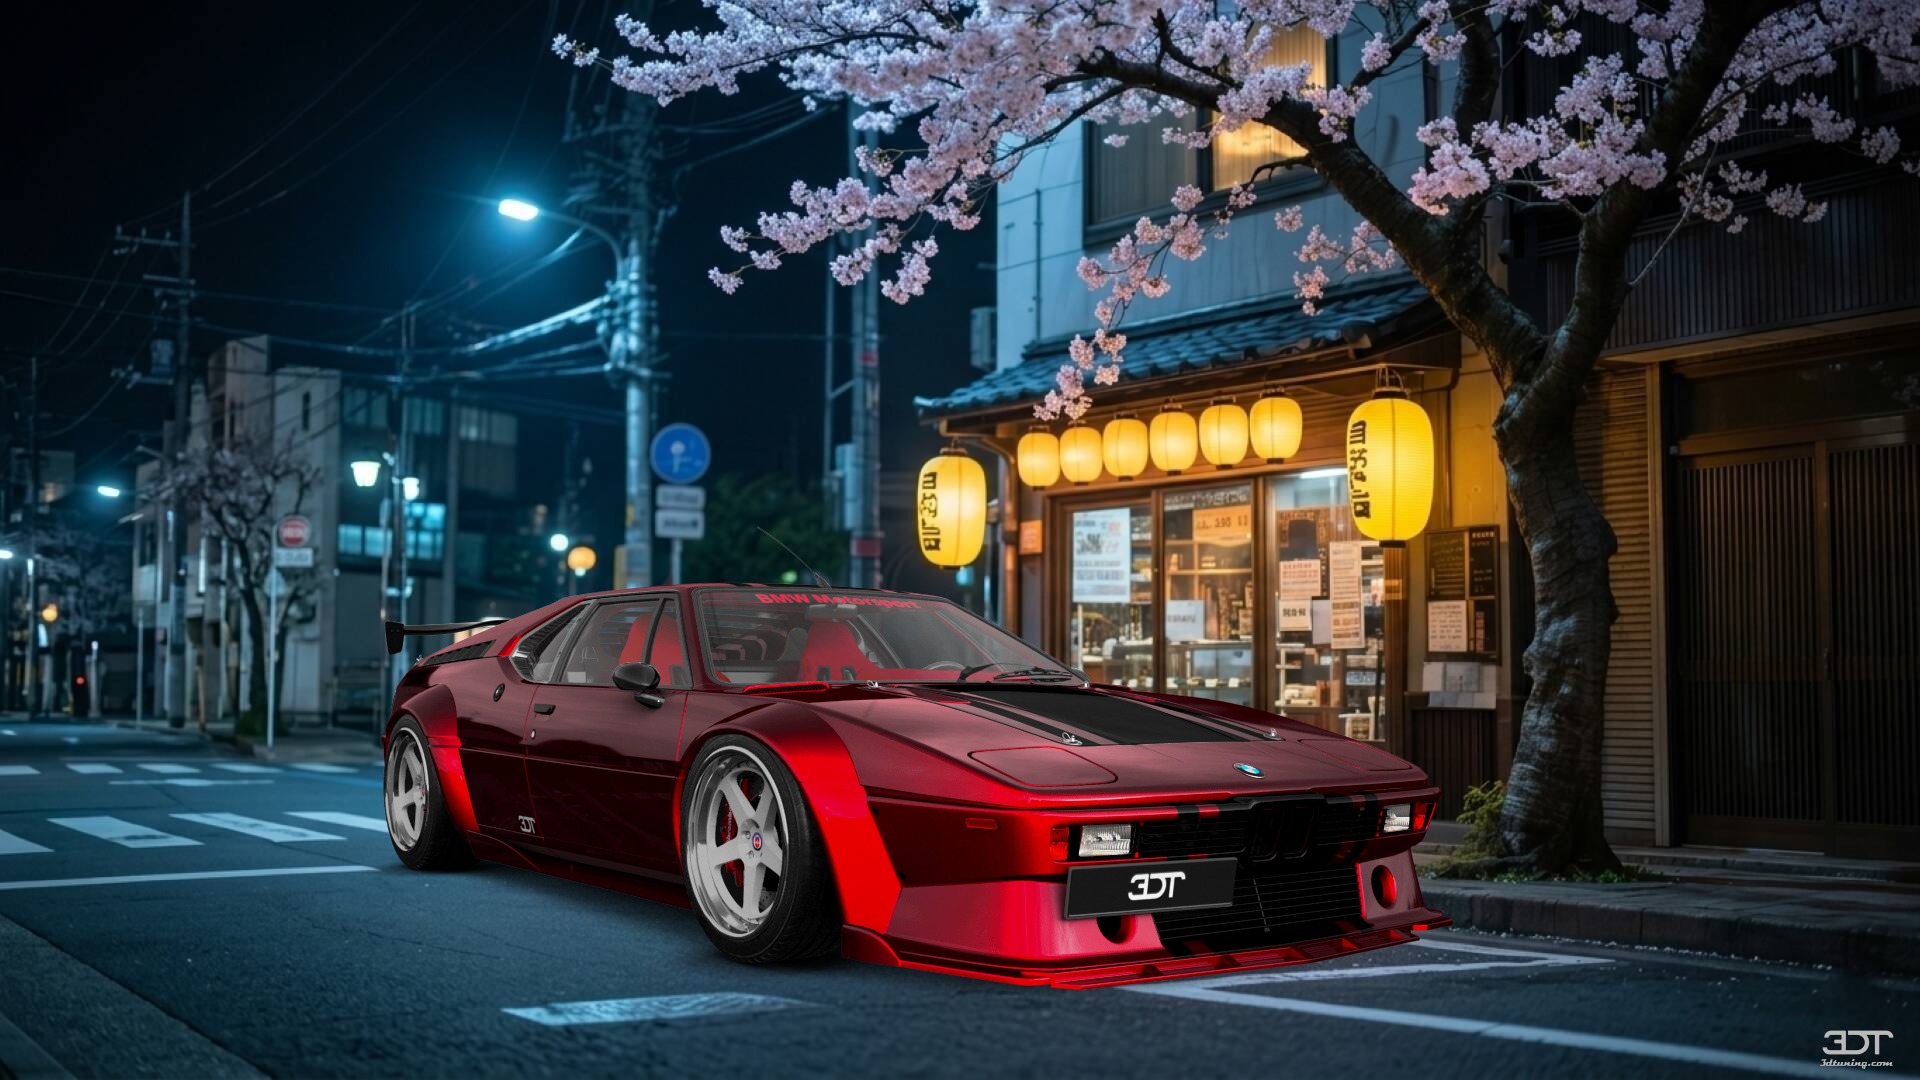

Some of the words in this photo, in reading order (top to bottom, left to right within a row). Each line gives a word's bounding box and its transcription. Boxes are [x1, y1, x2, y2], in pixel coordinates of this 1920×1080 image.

[755, 593, 810, 604] BMW
[812, 594, 921, 609] Motorsport
[518, 815, 536, 834] 3DT
[1127, 871, 1186, 901] 3DT
